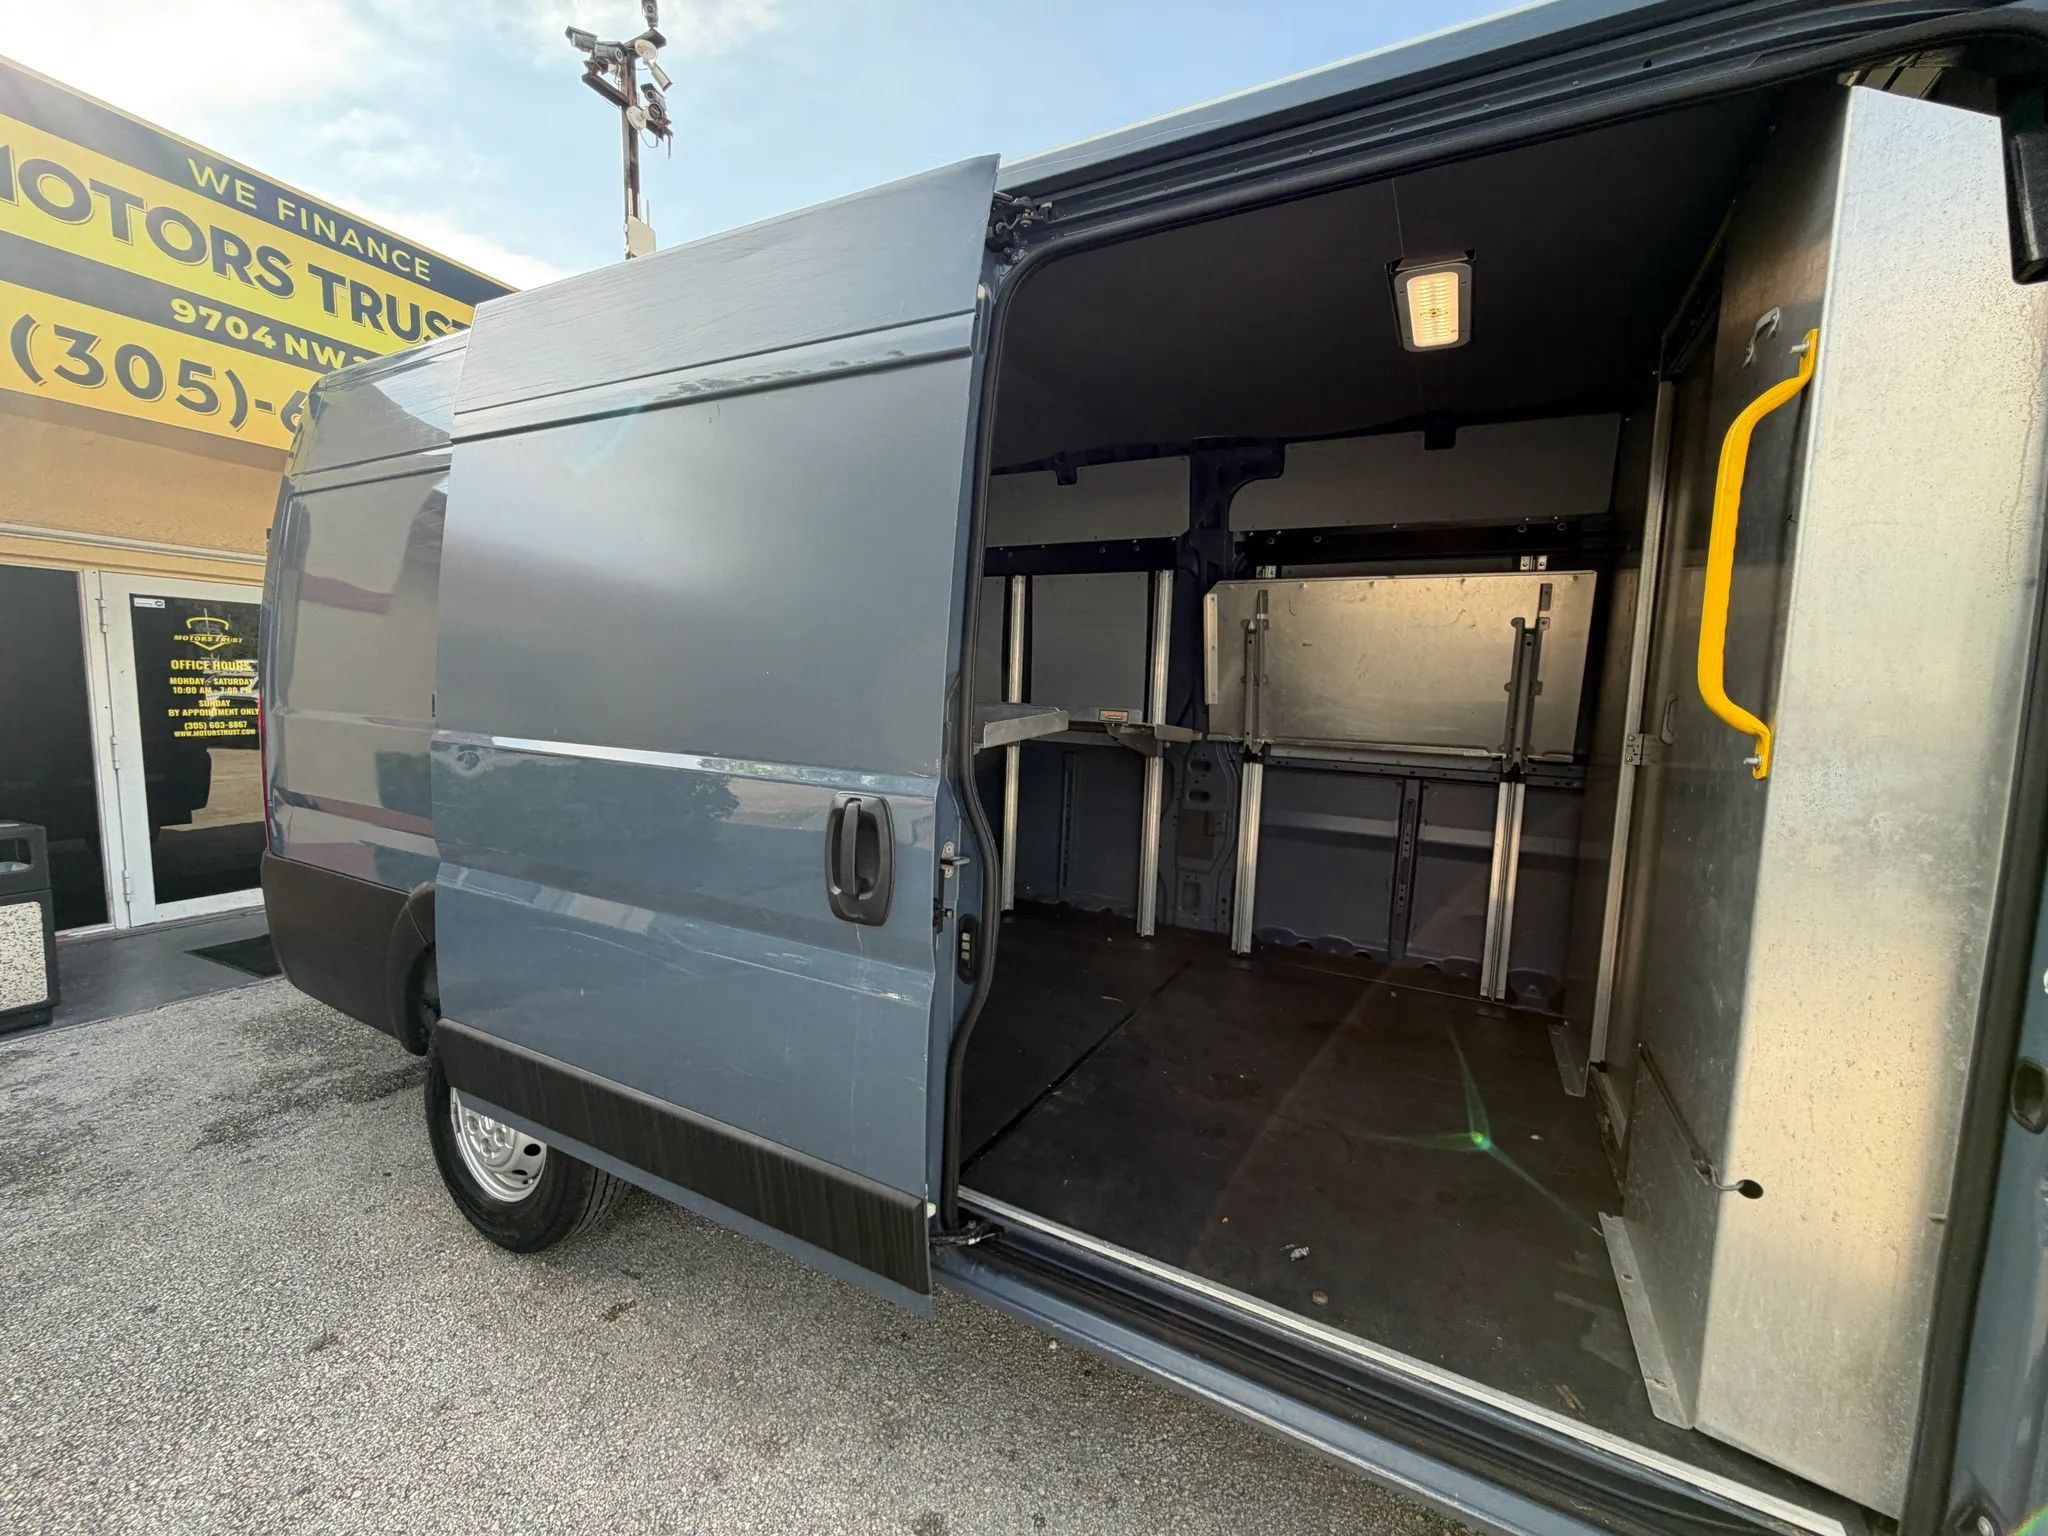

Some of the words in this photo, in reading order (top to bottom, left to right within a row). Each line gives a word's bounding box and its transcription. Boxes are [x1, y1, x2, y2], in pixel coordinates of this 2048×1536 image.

[187, 158, 258, 210] WE
[277, 197, 432, 282] FINANCE
[307, 263, 471, 345] TRUS
[170, 298, 277, 350] 9704
[284, 333, 346, 370] NW
[173, 634, 213, 642] MOTORS
[215, 635, 243, 643] TRUST
[170, 659, 210, 670] OFFICE
[212, 660, 250, 671] HOURS
[169, 677, 205, 685] MONDAY
[213, 678, 254, 686] SATURDAY
[172, 686, 197, 694] 10:00
[199, 686, 212, 694] AM
[198, 699, 231, 707] SUNDAY
[168, 709, 180, 717] BY
[182, 708, 239, 717] APPOINTMENT
[240, 708, 259, 716] ONLY
[184, 721, 207, 731] (305)
[173, 729, 256, 737] WWW.MOTORSTRUST.COM
